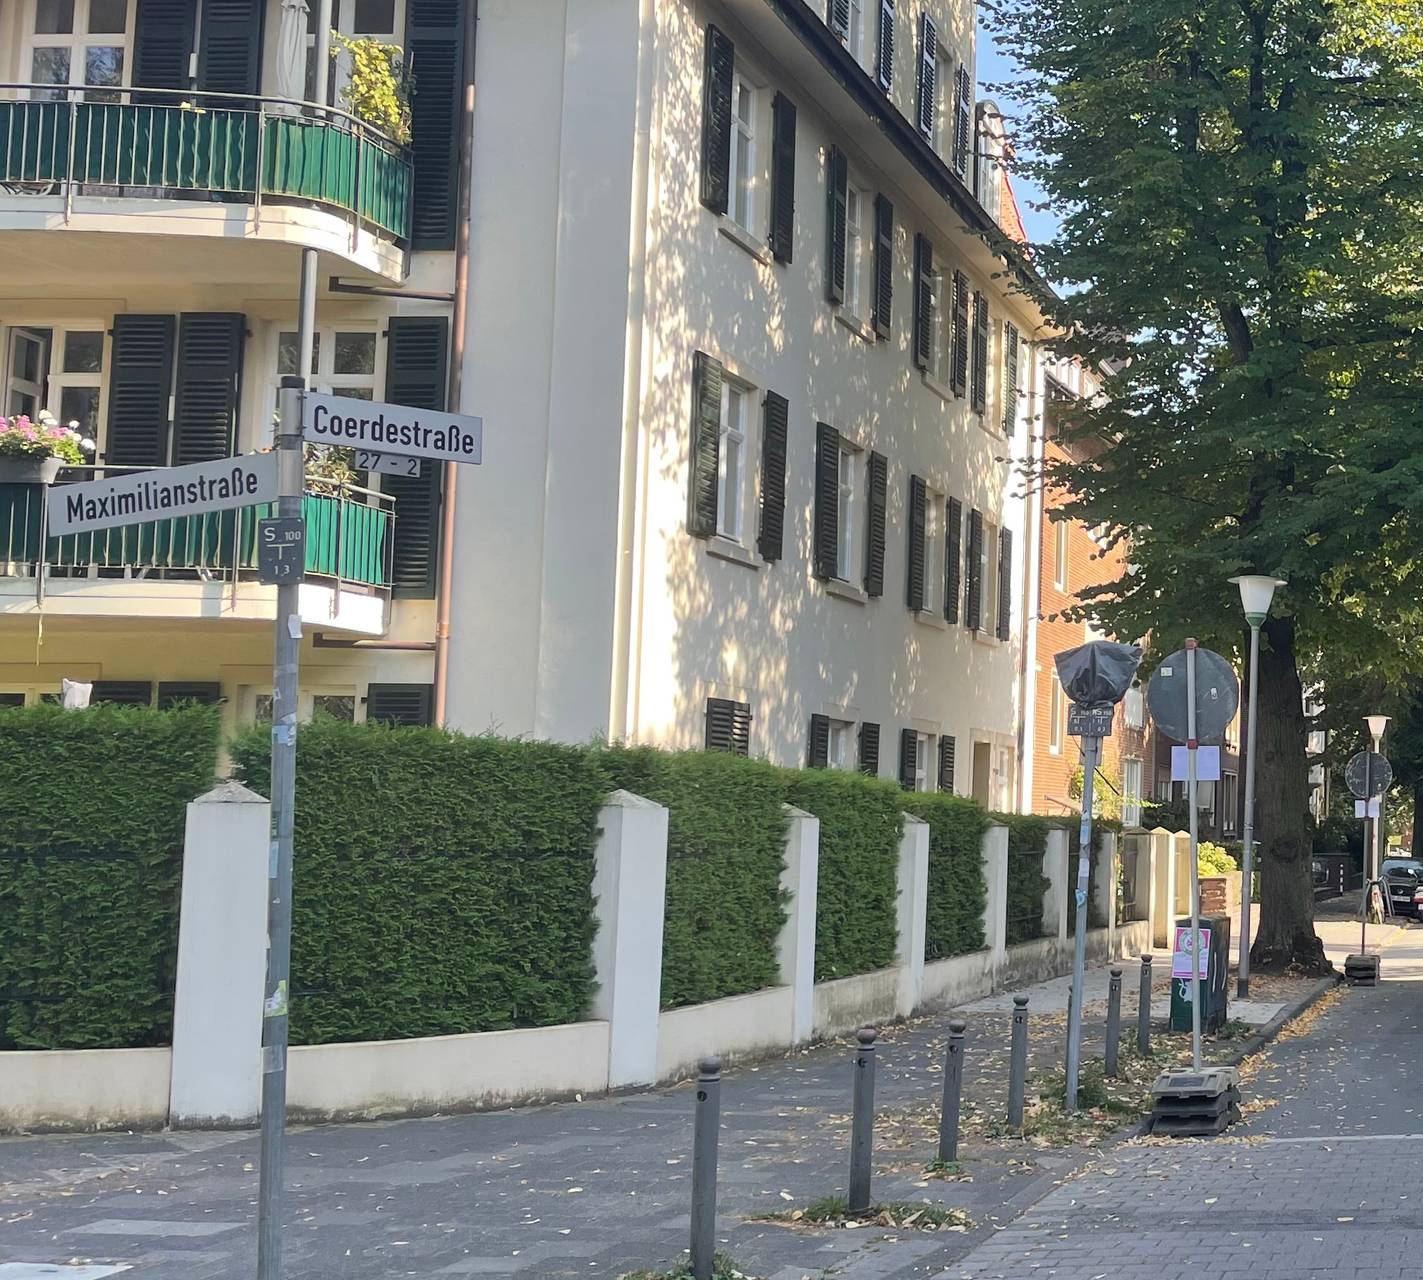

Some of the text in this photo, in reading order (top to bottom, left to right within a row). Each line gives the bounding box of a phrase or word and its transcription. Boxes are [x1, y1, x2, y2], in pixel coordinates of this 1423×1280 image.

[313, 405, 475, 454] Coerdestraße
[358, 452, 382, 472] 27
[406, 457, 418, 476] 2
[65, 467, 259, 524] Maximilianstraße
[263, 527, 302, 542] S 100
